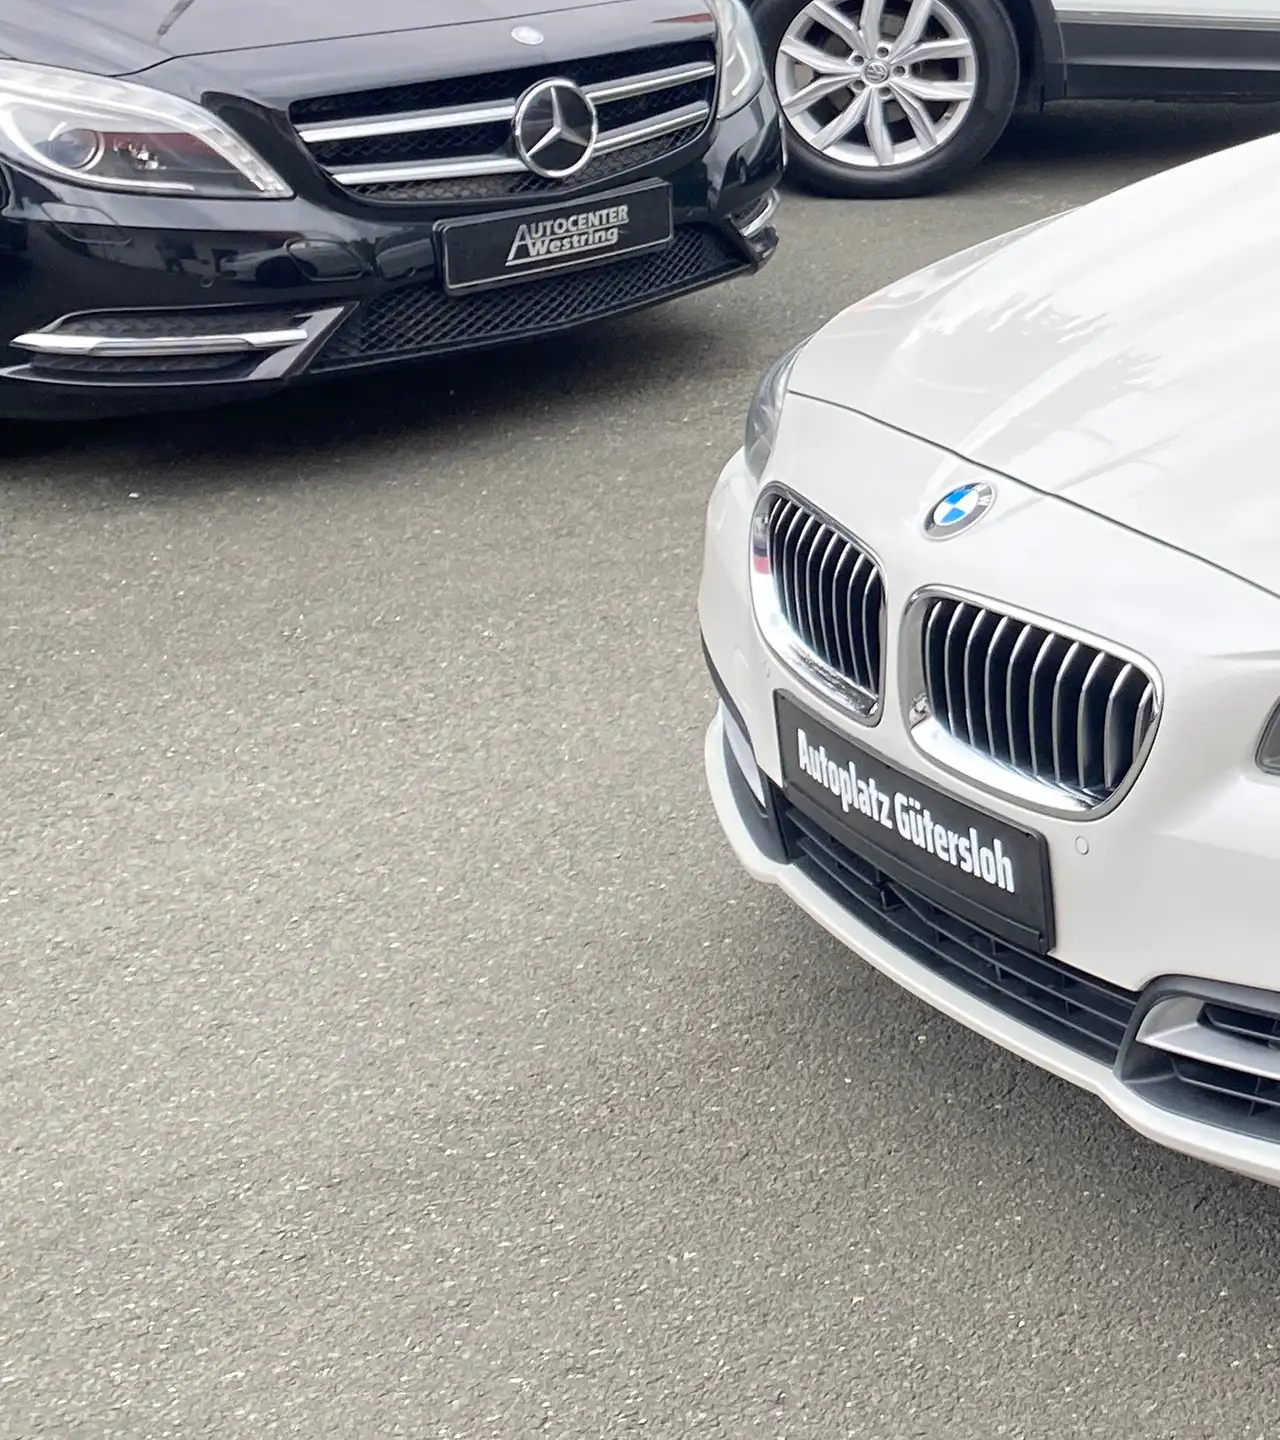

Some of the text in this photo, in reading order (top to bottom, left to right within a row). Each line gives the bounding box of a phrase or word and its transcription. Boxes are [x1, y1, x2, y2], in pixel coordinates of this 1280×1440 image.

[529, 226, 619, 257] Westring
[797, 728, 1015, 893] Autoplatz Gütersloh
